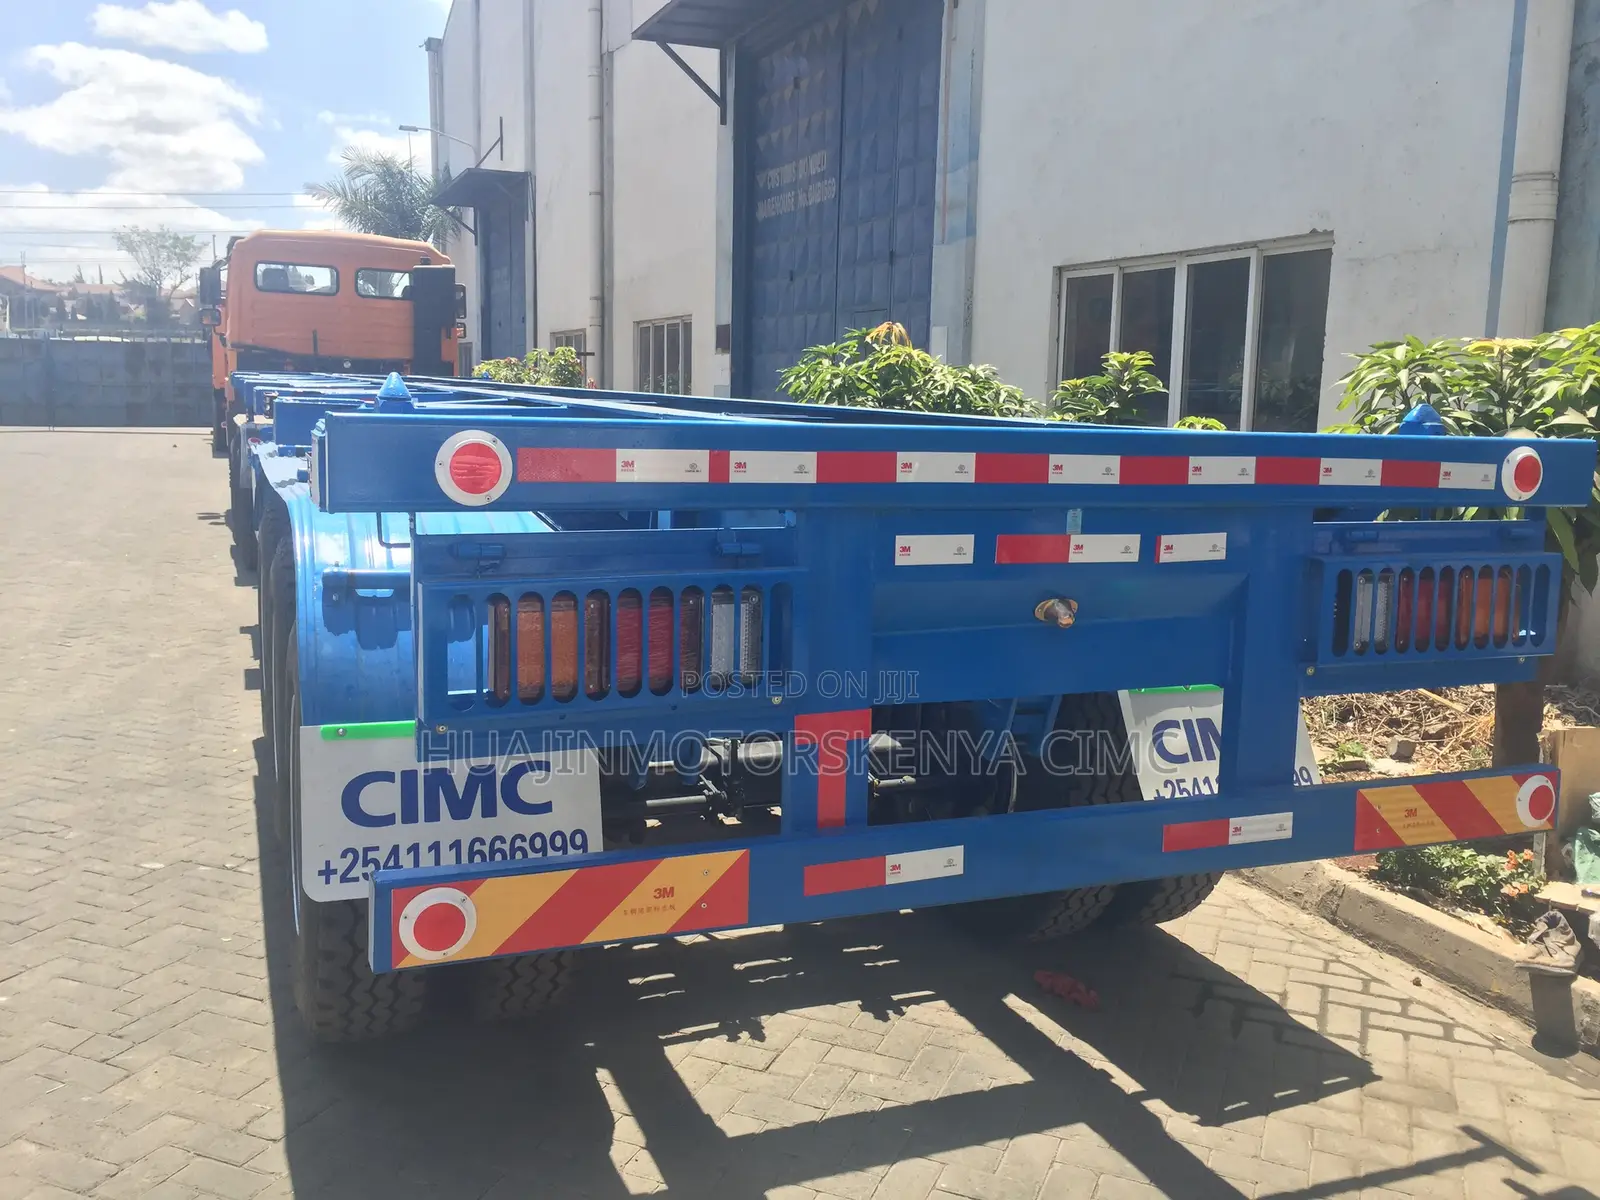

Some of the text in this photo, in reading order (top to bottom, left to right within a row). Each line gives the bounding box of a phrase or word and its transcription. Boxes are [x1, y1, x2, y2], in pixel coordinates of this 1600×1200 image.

[621, 460, 635, 468] 3M
[341, 760, 553, 828] CIMC
[1404, 808, 1418, 818] 3M
[653, 886, 675, 899] 3M
